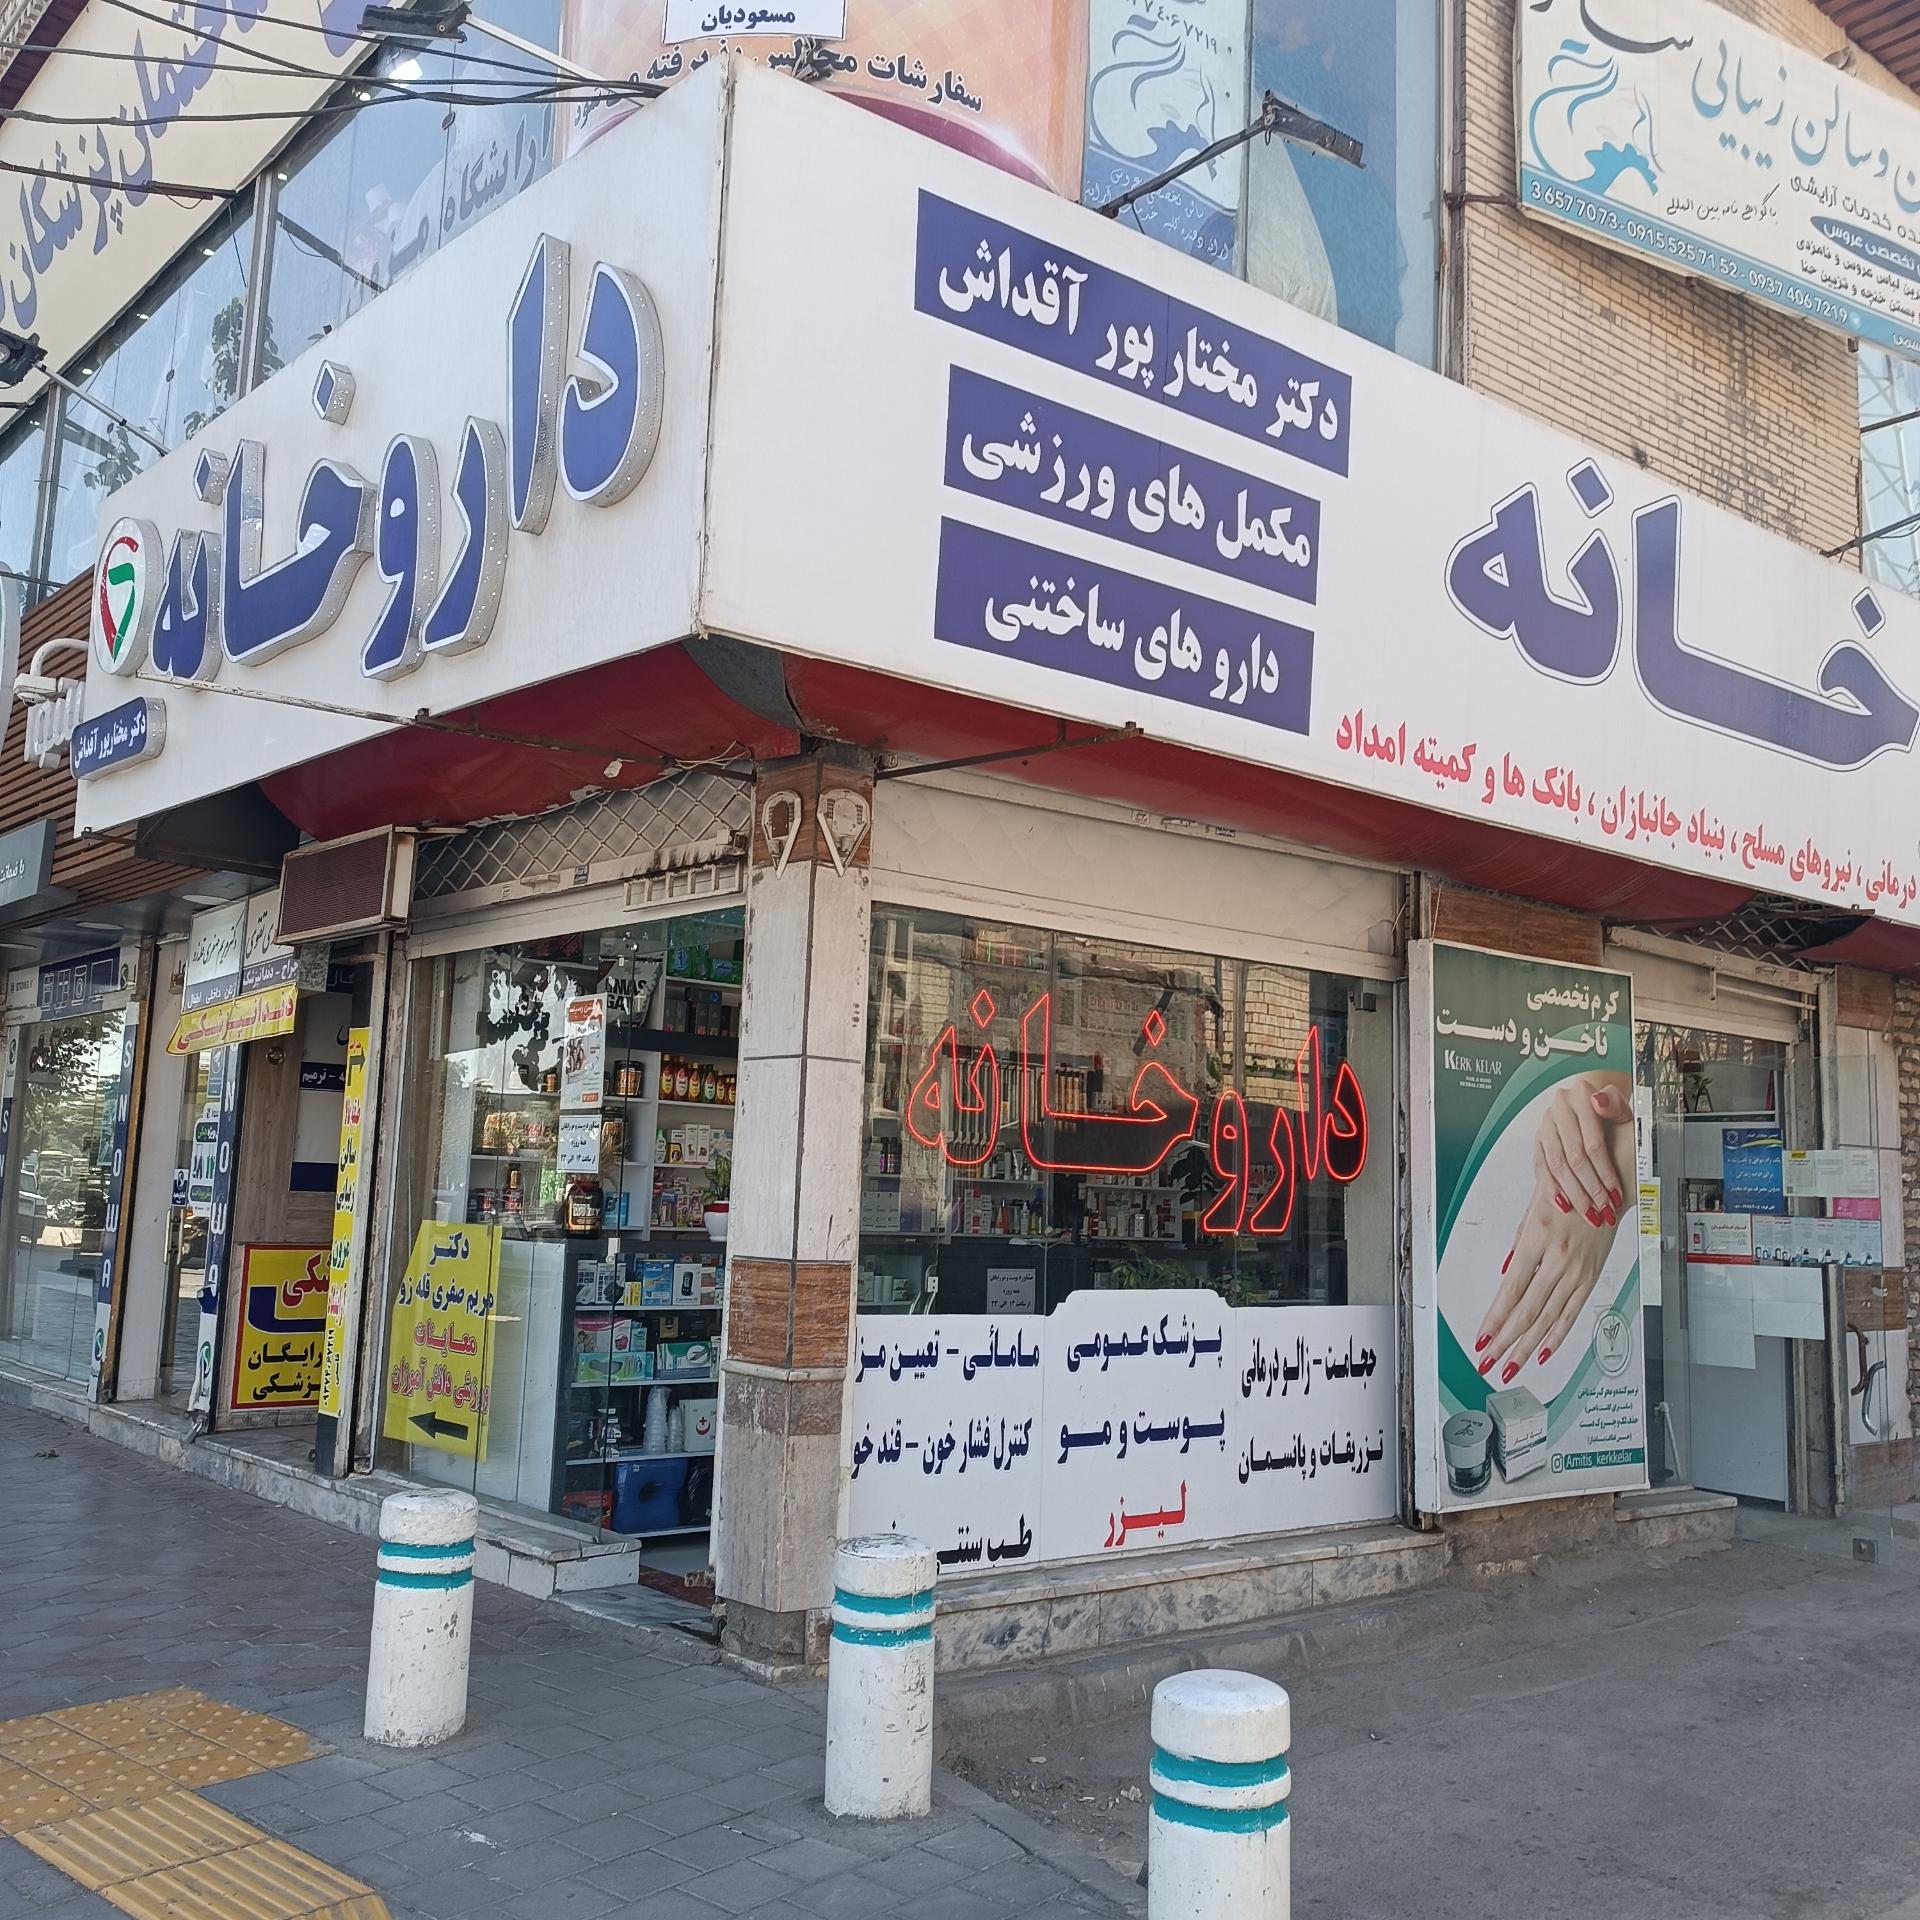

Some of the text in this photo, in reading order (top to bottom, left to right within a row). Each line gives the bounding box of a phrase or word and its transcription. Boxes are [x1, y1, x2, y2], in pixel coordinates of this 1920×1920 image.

[701, 5, 796, 31] مسعودیان
[867, 50, 983, 111] سفارشات
[1692, 38, 1788, 169] زیبایی
[1790, 176, 1838, 208] آرایشی
[1842, 196, 1892, 232] خدمات
[1823, 223, 1864, 250] عروس
[1864, 241, 1915, 271] تخصصی
[939, 239, 1338, 440] دکتر مختار پور آقداش
[151, 232, 664, 682] داروخانه
[962, 412, 1311, 567] مکمل های ورزشی
[985, 575, 1279, 704] دارو های ساختنی
[129, 711, 146, 747] دکتر
[1337, 709, 1917, 909] درمانی نیروهای مسلح بنیاد جانبازان بانک ها و کمیته امداد
[177, 990, 294, 1051] دندانپزشکی
[1527, 983, 1620, 1022] کرم تخصصی
[1436, 1009, 1608, 1057] ناخن و دست
[1475, 1058, 1502, 1076] KELAR
[906, 988, 1369, 1235] داروخانه
[101, 1040, 133, 1289] SNOWA
[429, 1231, 470, 1265] دکتر
[399, 1276, 413, 1305] زو
[432, 1278, 465, 1312] صفری
[466, 1287, 494, 1316] مریم
[248, 1341, 323, 1370] رایگان
[415, 1318, 477, 1357] معاینات
[889, 1330, 941, 1381] تعیین
[963, 1324, 1040, 1381] مامائی
[1065, 1314, 1223, 1373] پزشک عمومی
[1326, 1333, 1377, 1389] حجامت
[252, 1371, 321, 1400] زشکی
[391, 1357, 489, 1414] ورزشی دانش آموزان
[1241, 1337, 1278, 1399] درمانی
[851, 1422, 874, 1479] خو
[878, 1418, 901, 1464] قند
[923, 1420, 956, 1474] خون
[958, 1416, 991, 1473] فشار
[994, 1416, 1032, 1470] کنترل
[1057, 1407, 1225, 1464] پوست و مو
[1238, 1429, 1384, 1485] تزریقات و پانسمان
[1104, 1479, 1188, 1548] لیزر
[987, 1514, 1032, 1568] طب
